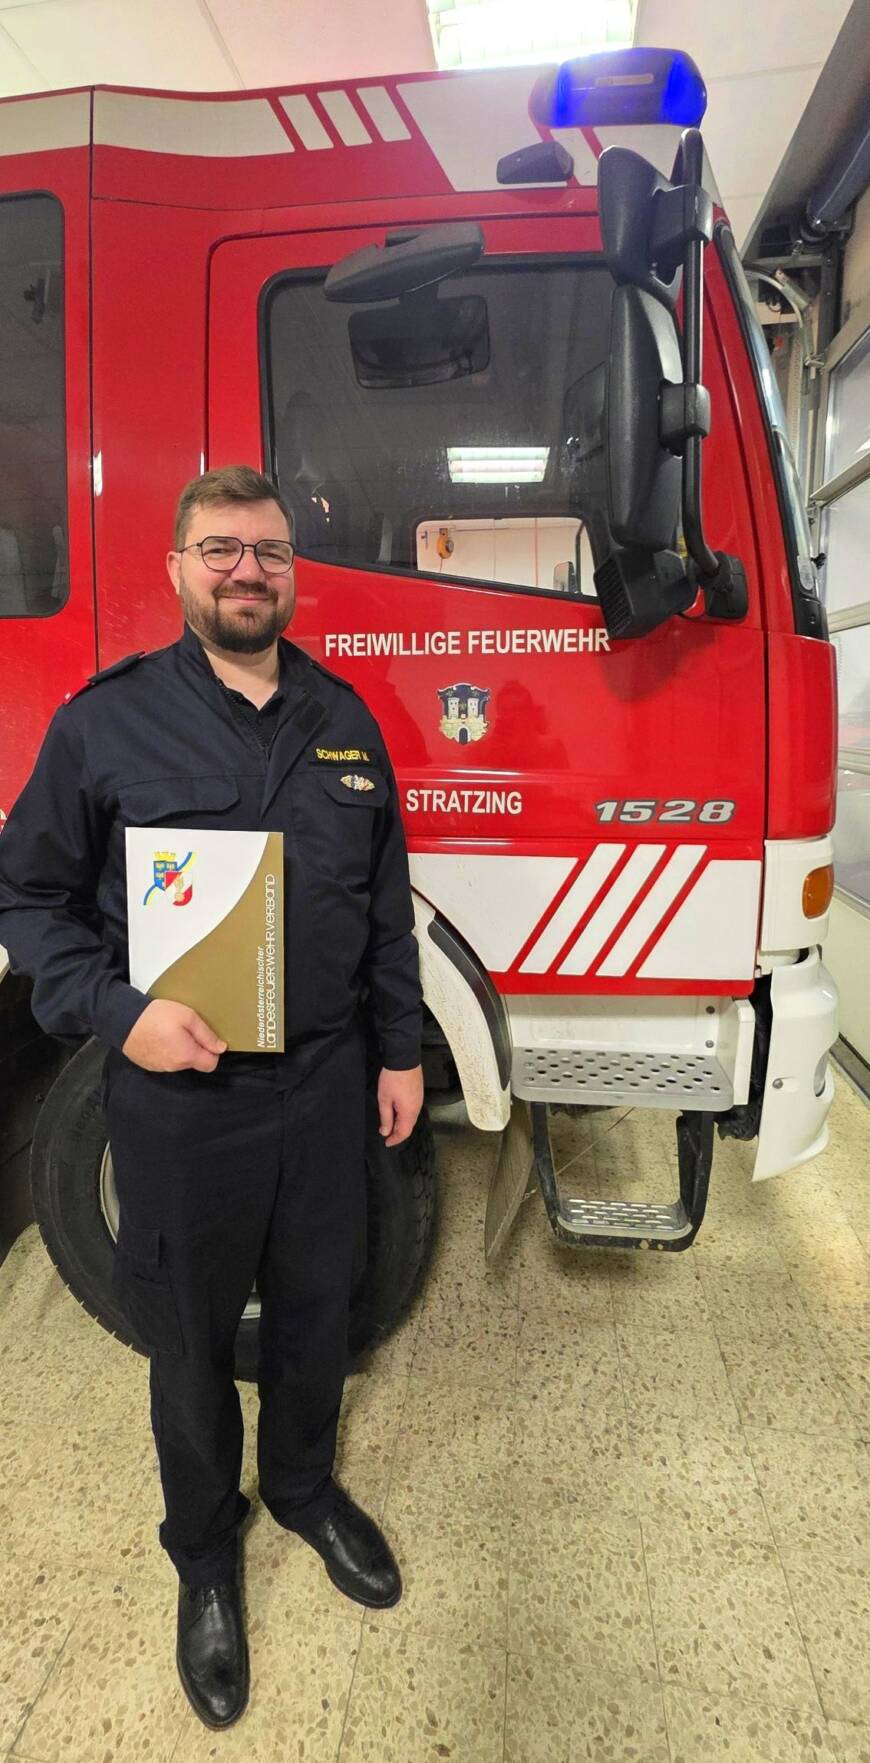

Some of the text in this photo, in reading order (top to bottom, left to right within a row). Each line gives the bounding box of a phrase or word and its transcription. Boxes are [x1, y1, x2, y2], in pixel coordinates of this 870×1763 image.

[325, 628, 611, 657] FREIWILLIGE FEUERWEHR
[405, 789, 523, 815] STRATZING
[596, 799, 736, 823] 1528
[256, 945, 266, 1048] Niederösterreichischer
